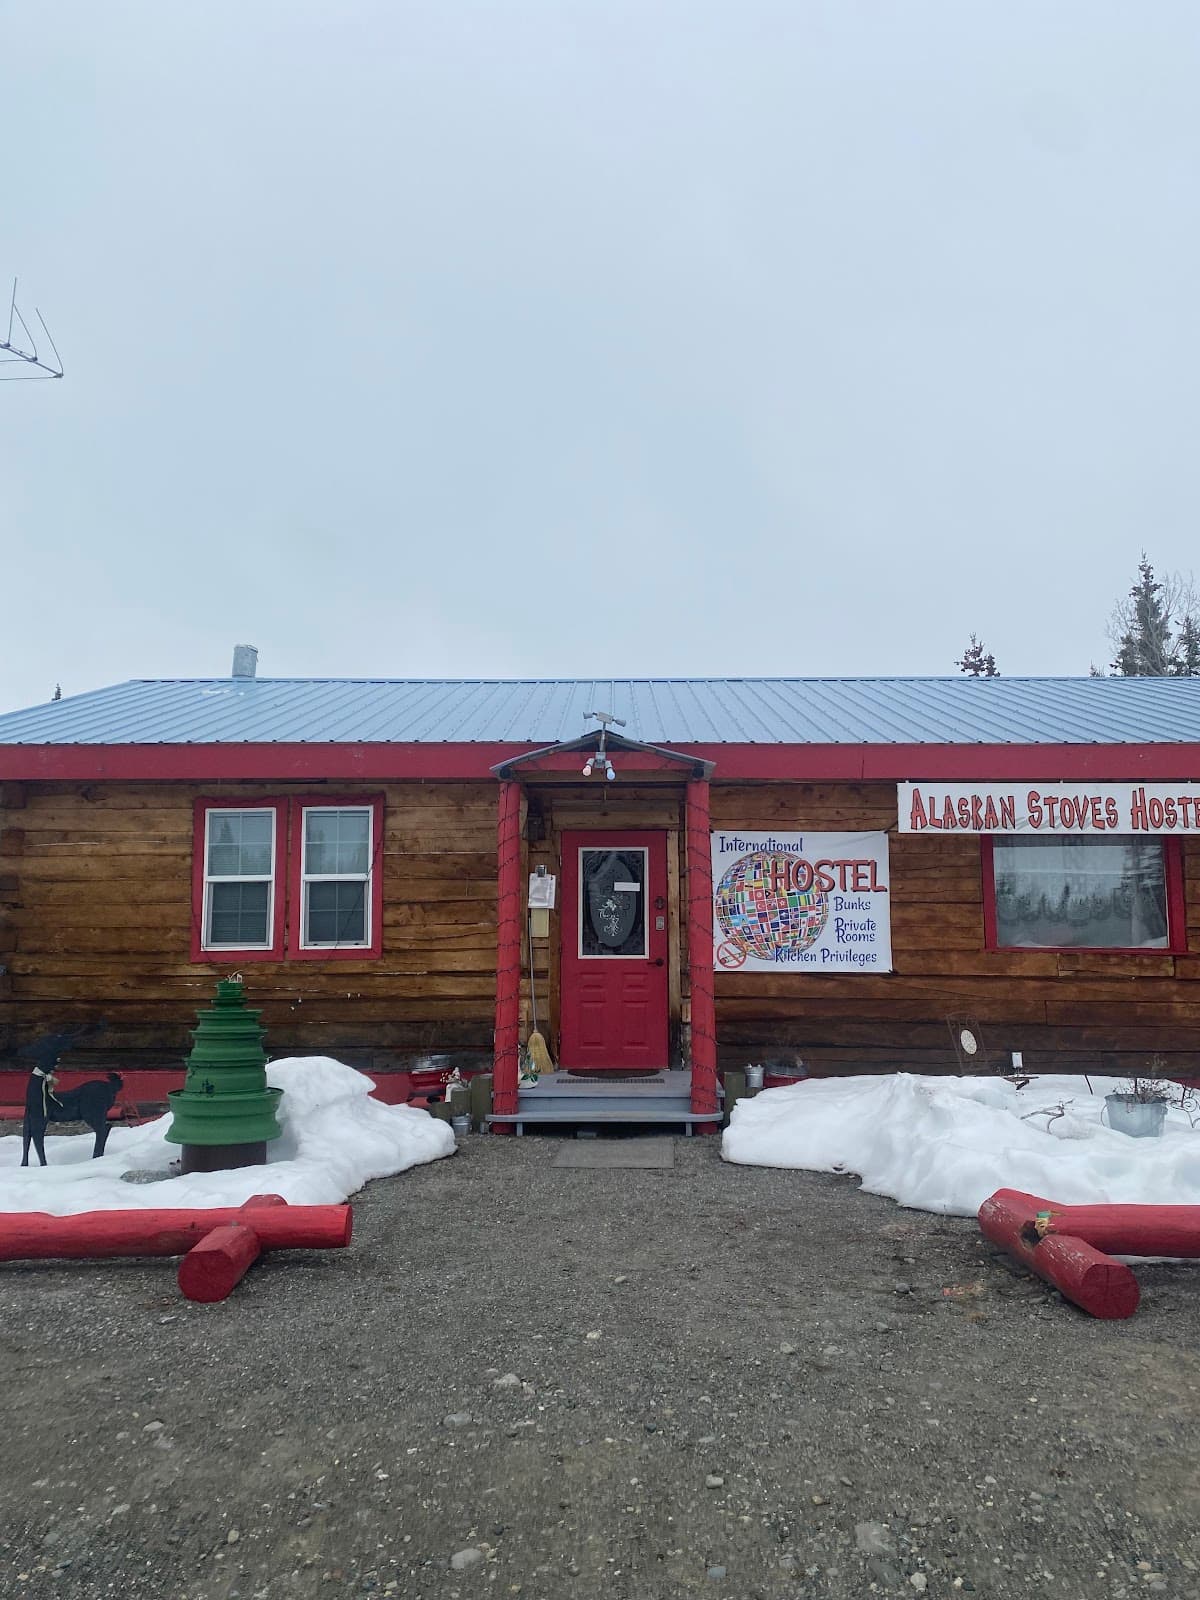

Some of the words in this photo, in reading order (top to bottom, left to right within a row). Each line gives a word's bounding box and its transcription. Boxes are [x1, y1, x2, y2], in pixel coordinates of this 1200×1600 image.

[910, 787, 1016, 831] ALASKAN
[1027, 790, 1119, 831] STOVES
[719, 836, 803, 853] International
[769, 859, 888, 893] HOSTEL
[833, 896, 871, 912] Bunks
[834, 917, 876, 932] Private
[835, 928, 876, 944] Rooms
[774, 947, 817, 963] Kitchen
[820, 948, 878, 967] Privileges
